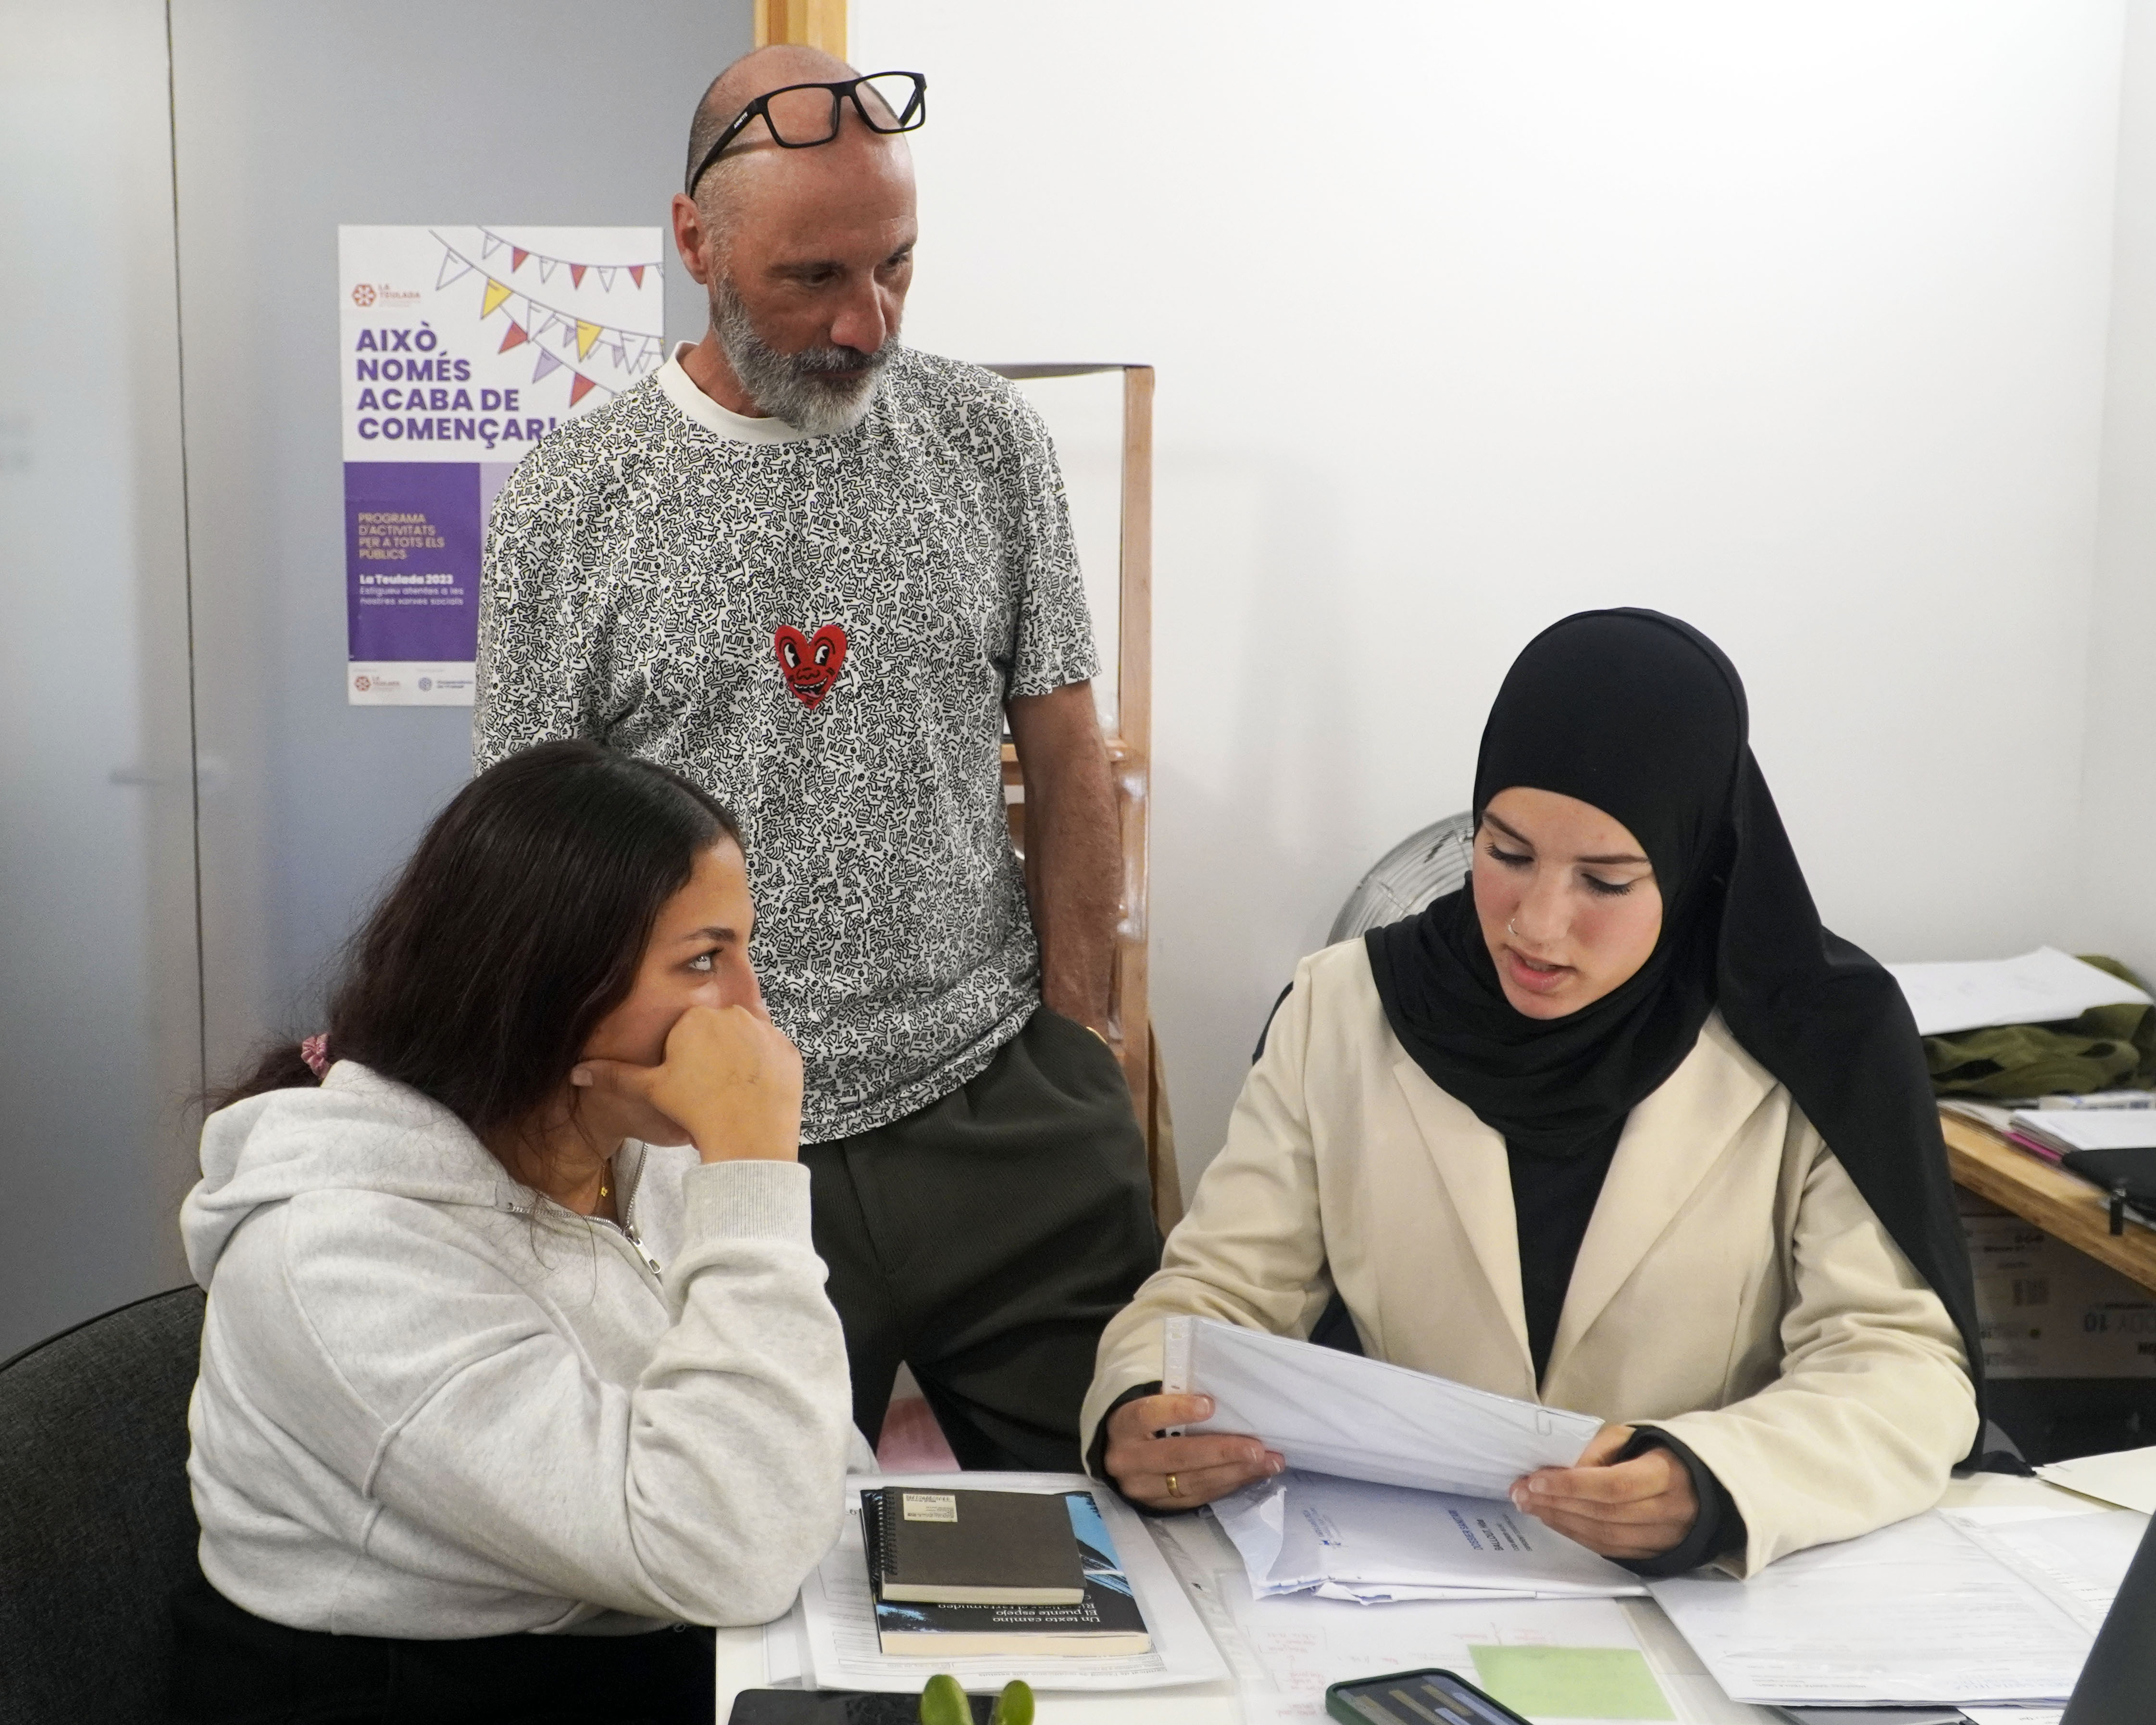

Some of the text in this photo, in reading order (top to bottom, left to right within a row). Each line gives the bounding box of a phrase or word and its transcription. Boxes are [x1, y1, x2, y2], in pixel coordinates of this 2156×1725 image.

[355, 321, 437, 352] AIXÒ
[356, 351, 470, 382] NOMÉS
[358, 388, 519, 411] ACABA DE
[358, 417, 555, 449] COMENÇAR!
[359, 512, 426, 524] PROGRAMA
[359, 537, 445, 548] PER A TOTS ELS
[360, 574, 454, 585] La Teulada 2023
